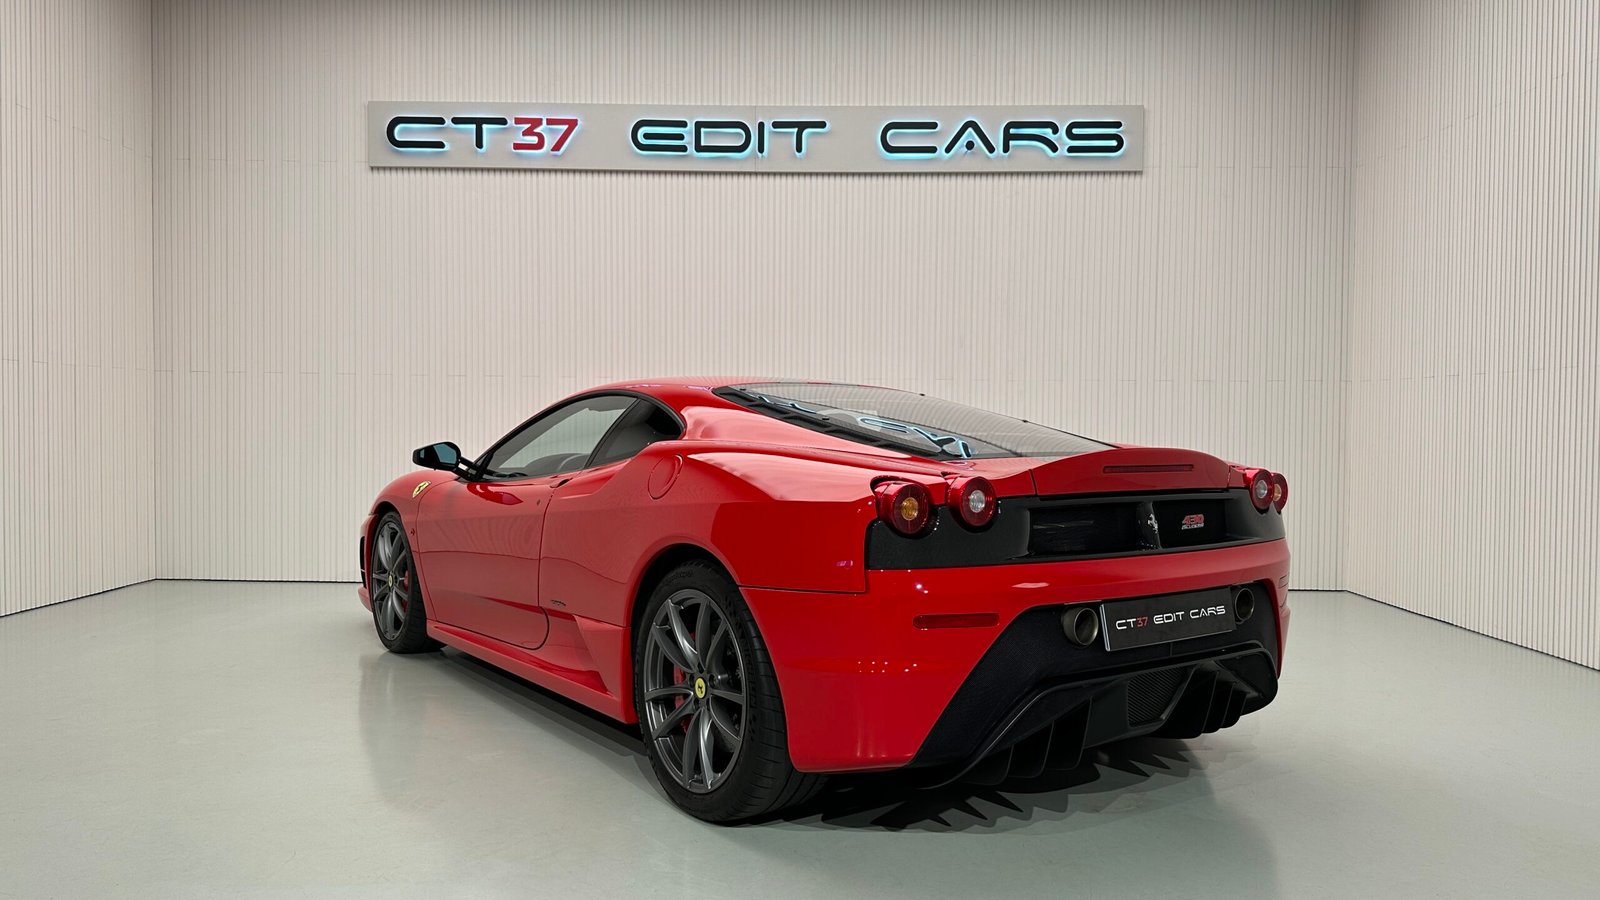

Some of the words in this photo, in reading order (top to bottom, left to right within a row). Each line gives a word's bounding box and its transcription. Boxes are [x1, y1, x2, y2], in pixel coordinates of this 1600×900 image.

[386, 116, 578, 152] CT37
[630, 119, 827, 154] EDIT
[880, 120, 1125, 154] CARS
[1182, 514, 1205, 525] 430
[1115, 616, 1149, 630] CT37
[1153, 611, 1185, 625] EDIT
[1189, 605, 1226, 619] CARS
